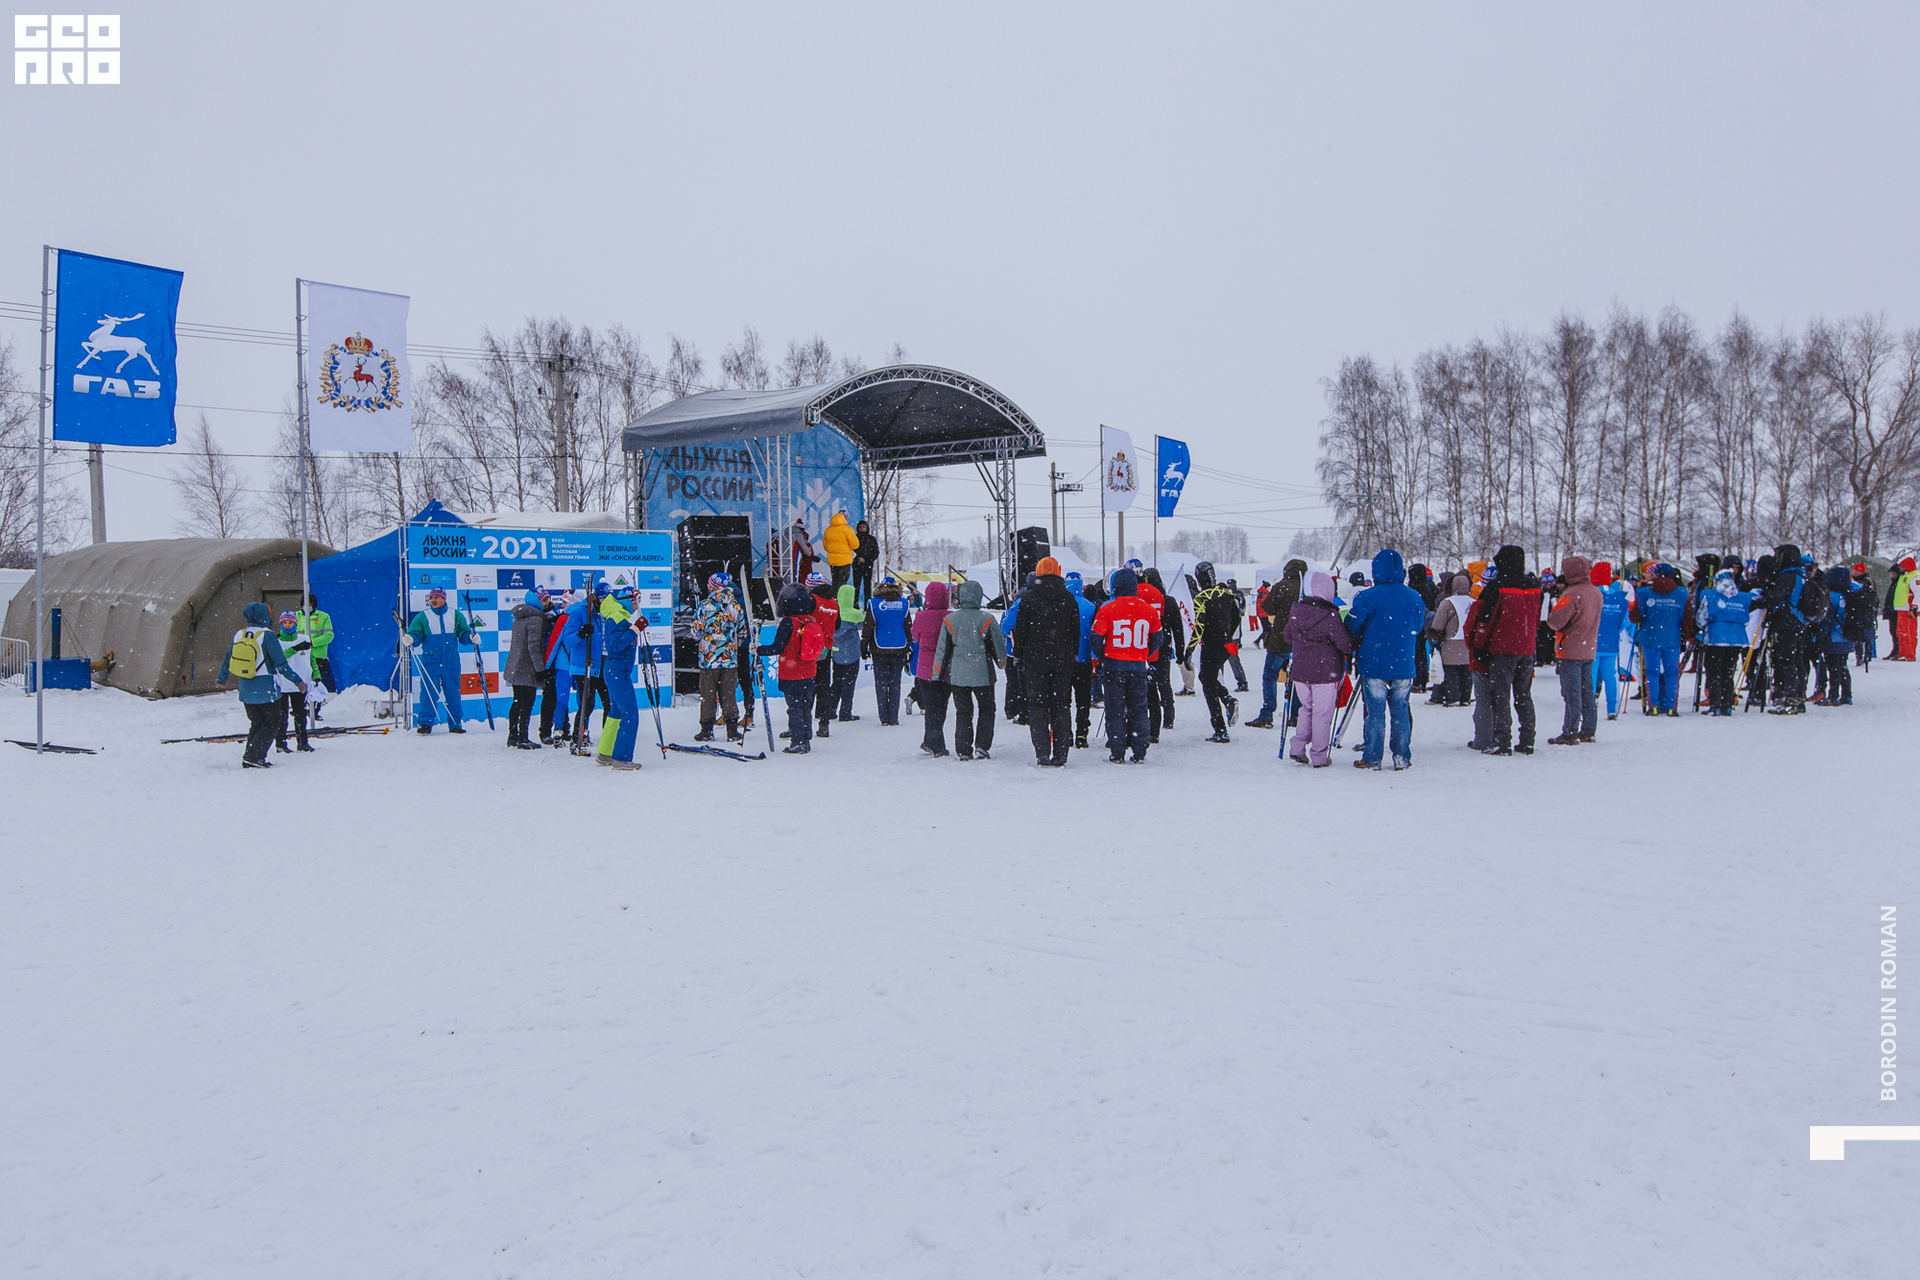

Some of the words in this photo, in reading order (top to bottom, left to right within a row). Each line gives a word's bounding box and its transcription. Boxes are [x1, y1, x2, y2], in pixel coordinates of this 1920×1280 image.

[73, 373, 161, 399] ГАЗ
[664, 445, 752, 473] ЛЫЖНЯ
[666, 474, 754, 502] РОССИИ
[422, 535, 466, 547] ЛЫЖНЯ
[423, 547, 467, 558] РОССИИ
[481, 536, 548, 559] 2021
[611, 553, 641, 561] «ОКСКИЙ
[1112, 618, 1150, 649] 50
